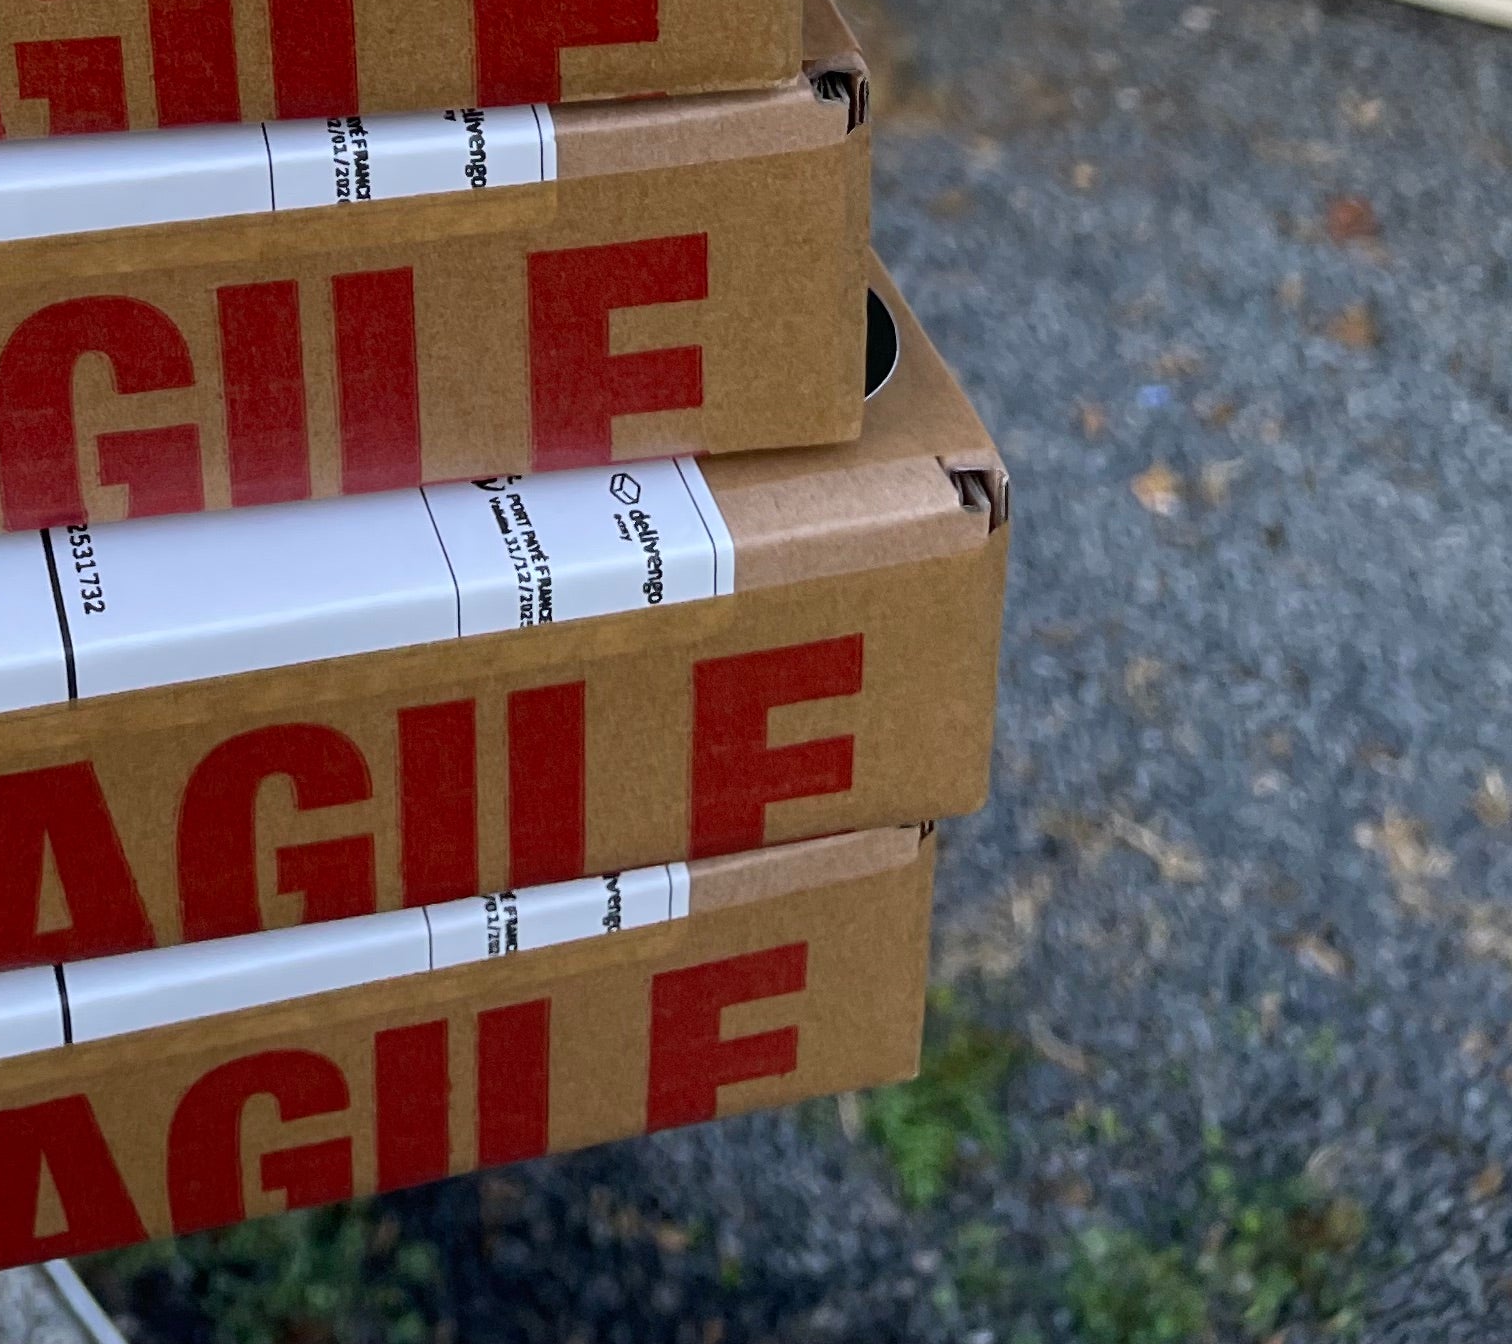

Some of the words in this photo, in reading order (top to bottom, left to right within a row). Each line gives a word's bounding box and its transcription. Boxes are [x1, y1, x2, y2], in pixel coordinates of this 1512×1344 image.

[506, 494, 532, 528] PORT
[521, 530, 549, 563] PAYÉ
[629, 510, 664, 604] delivengo
